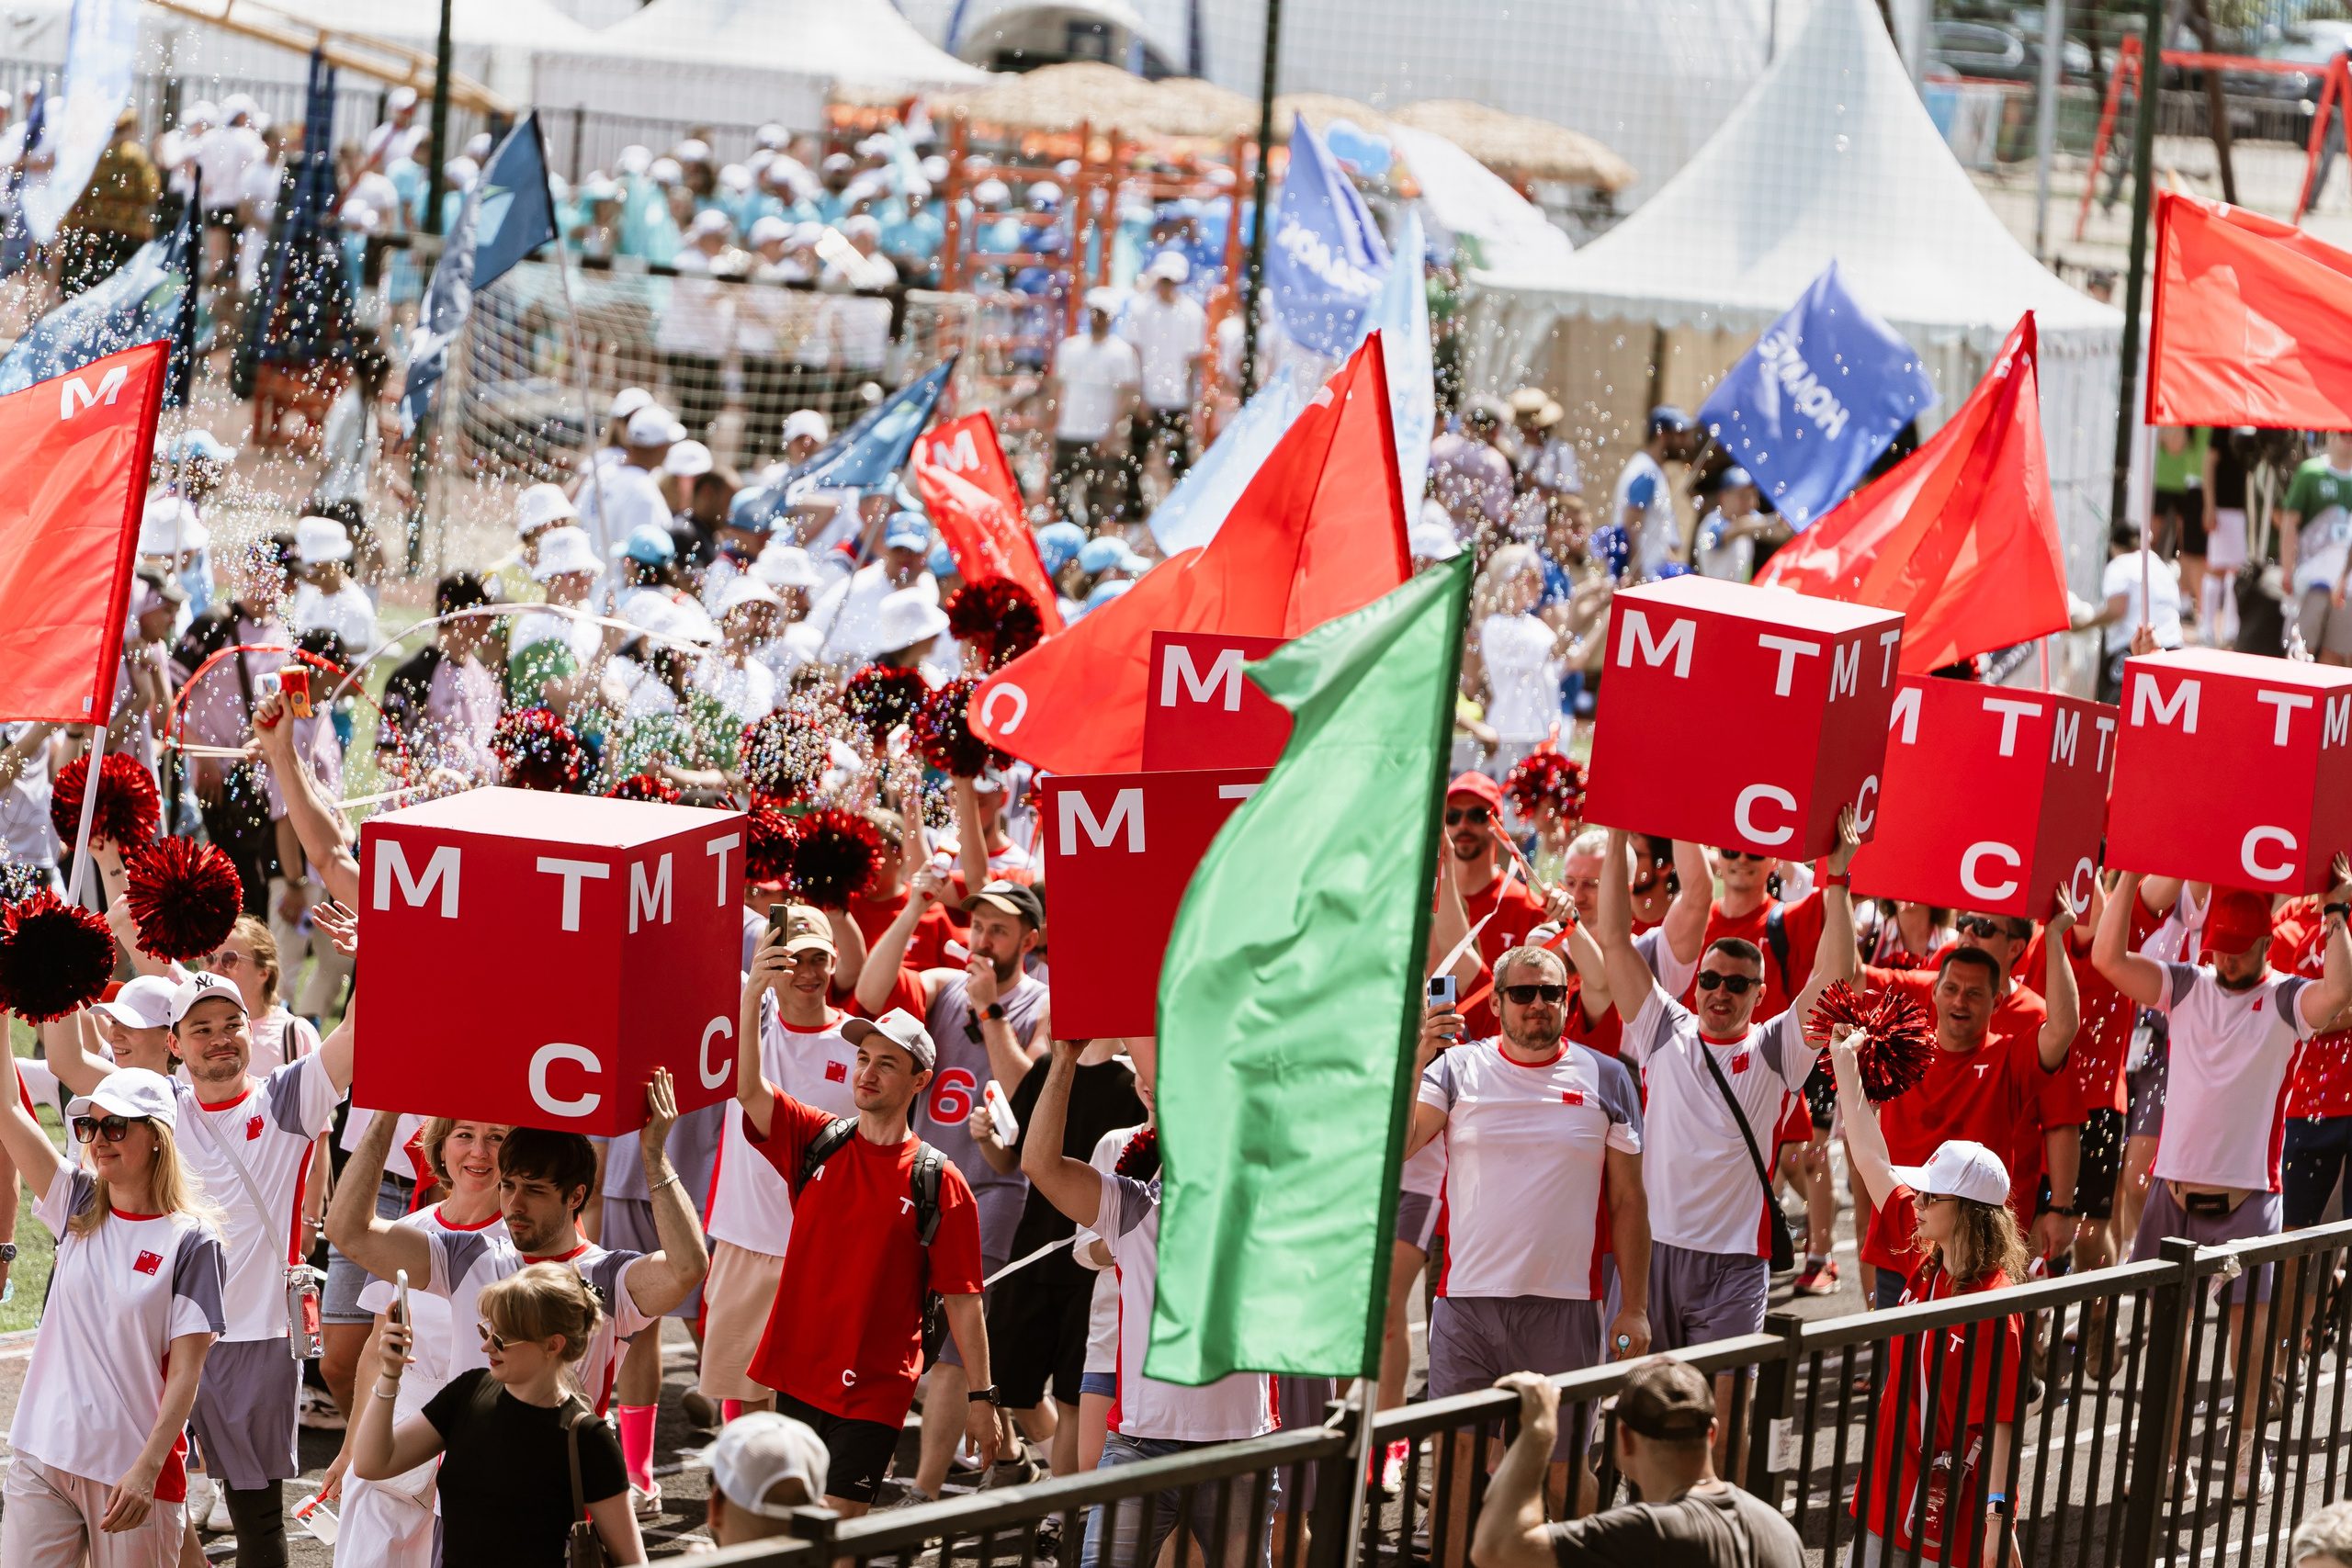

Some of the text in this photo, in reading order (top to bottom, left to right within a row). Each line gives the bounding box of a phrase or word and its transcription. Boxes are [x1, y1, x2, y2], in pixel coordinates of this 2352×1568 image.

[1160, 645, 1244, 711] М
[1617, 609, 1820, 696] М Т
[1829, 629, 1900, 702] М Т
[1983, 697, 2042, 757] Т
[2132, 672, 2312, 746] М Т
[1058, 788, 1145, 855] М
[1735, 784, 1796, 845] С
[374, 840, 609, 931] М Т
[629, 832, 740, 933] М Т
[1961, 841, 2020, 900] С
[2241, 826, 2297, 882] С
[529, 1043, 601, 1117] С
[700, 1016, 732, 1089] С
[930, 1067, 978, 1127] 6
